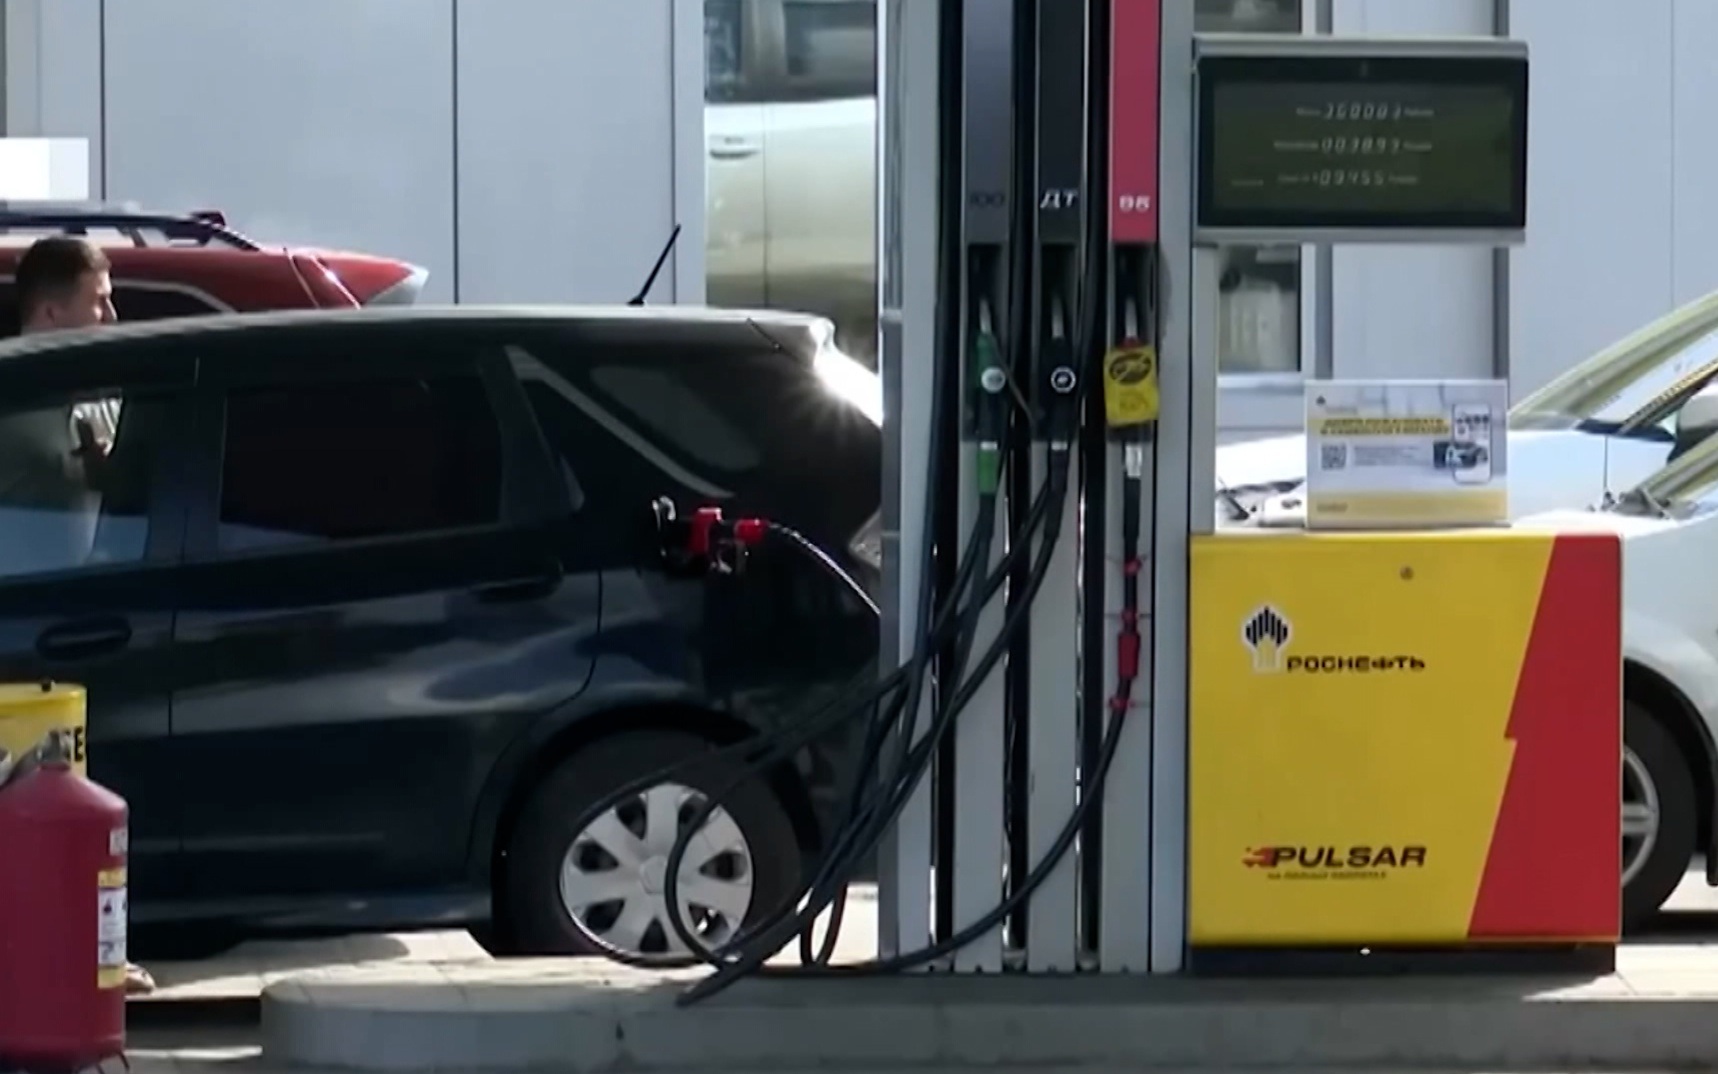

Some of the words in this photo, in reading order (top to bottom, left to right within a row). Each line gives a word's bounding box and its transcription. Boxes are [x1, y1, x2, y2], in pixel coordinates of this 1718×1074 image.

[1040, 190, 1078, 208] ДТ
[1287, 655, 1426, 673] РОСНЕФТЬ
[1270, 846, 1427, 868] PULSAR
